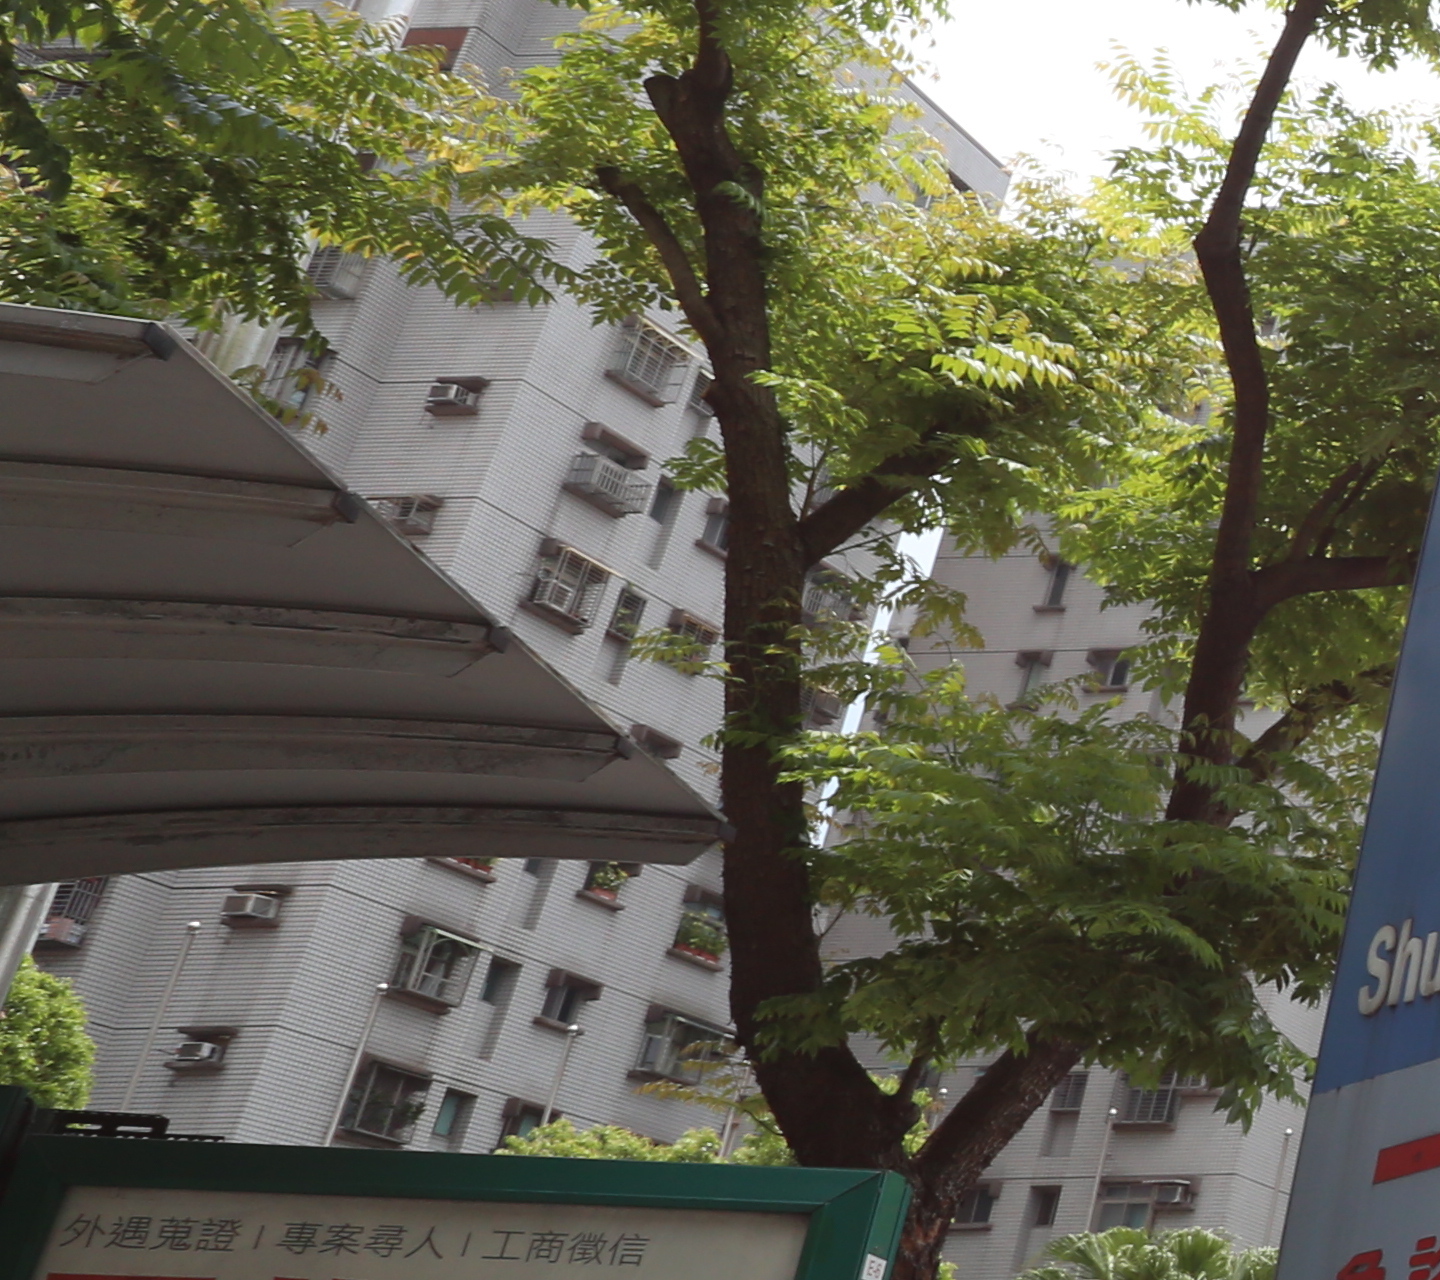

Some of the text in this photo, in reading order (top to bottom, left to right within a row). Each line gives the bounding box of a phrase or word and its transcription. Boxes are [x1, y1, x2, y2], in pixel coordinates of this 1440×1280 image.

[60, 1214, 649, 1266] 外遇蒐證 專案尋人 工商徵信
